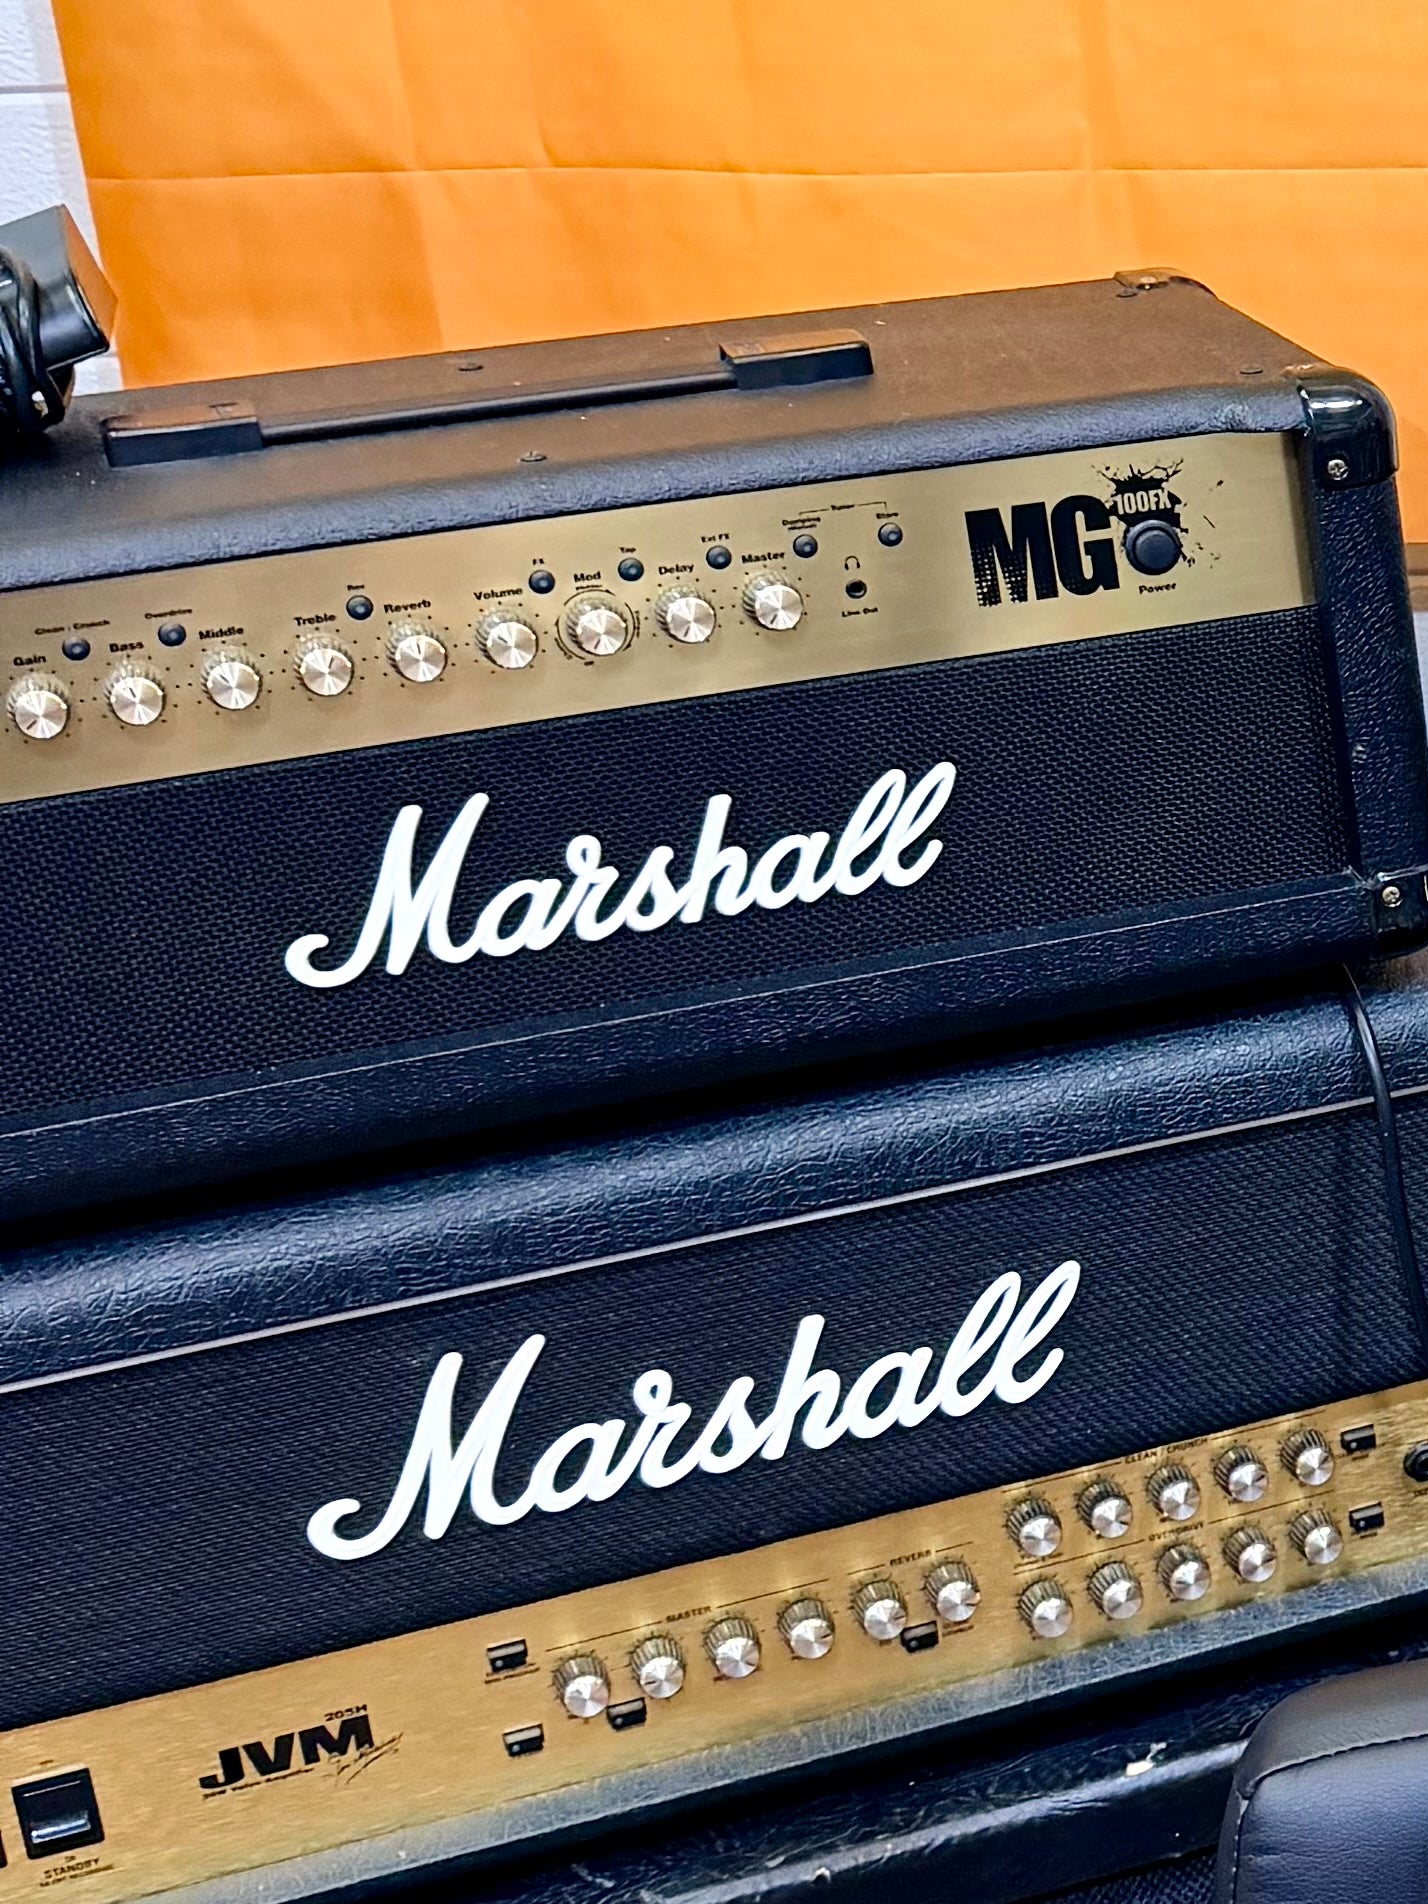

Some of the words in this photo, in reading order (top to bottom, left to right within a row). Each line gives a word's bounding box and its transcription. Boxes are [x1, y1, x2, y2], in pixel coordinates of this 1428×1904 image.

[1115, 487, 1172, 515] 100FX
[741, 551, 785, 564] Master
[965, 494, 1121, 608] MG
[658, 563, 694, 575] Delay
[573, 571, 601, 583] Mod
[473, 587, 523, 601] Volume
[1138, 582, 1177, 594] Power
[384, 599, 431, 613] Reverb
[294, 613, 336, 627] Treble
[199, 626, 244, 640] Middle
[109, 640, 144, 653] Bass
[13, 654, 47, 667] Gain
[285, 762, 957, 988] Marshall
[308, 1261, 1081, 1560] Marshall
[198, 1714, 375, 1789] JVM
